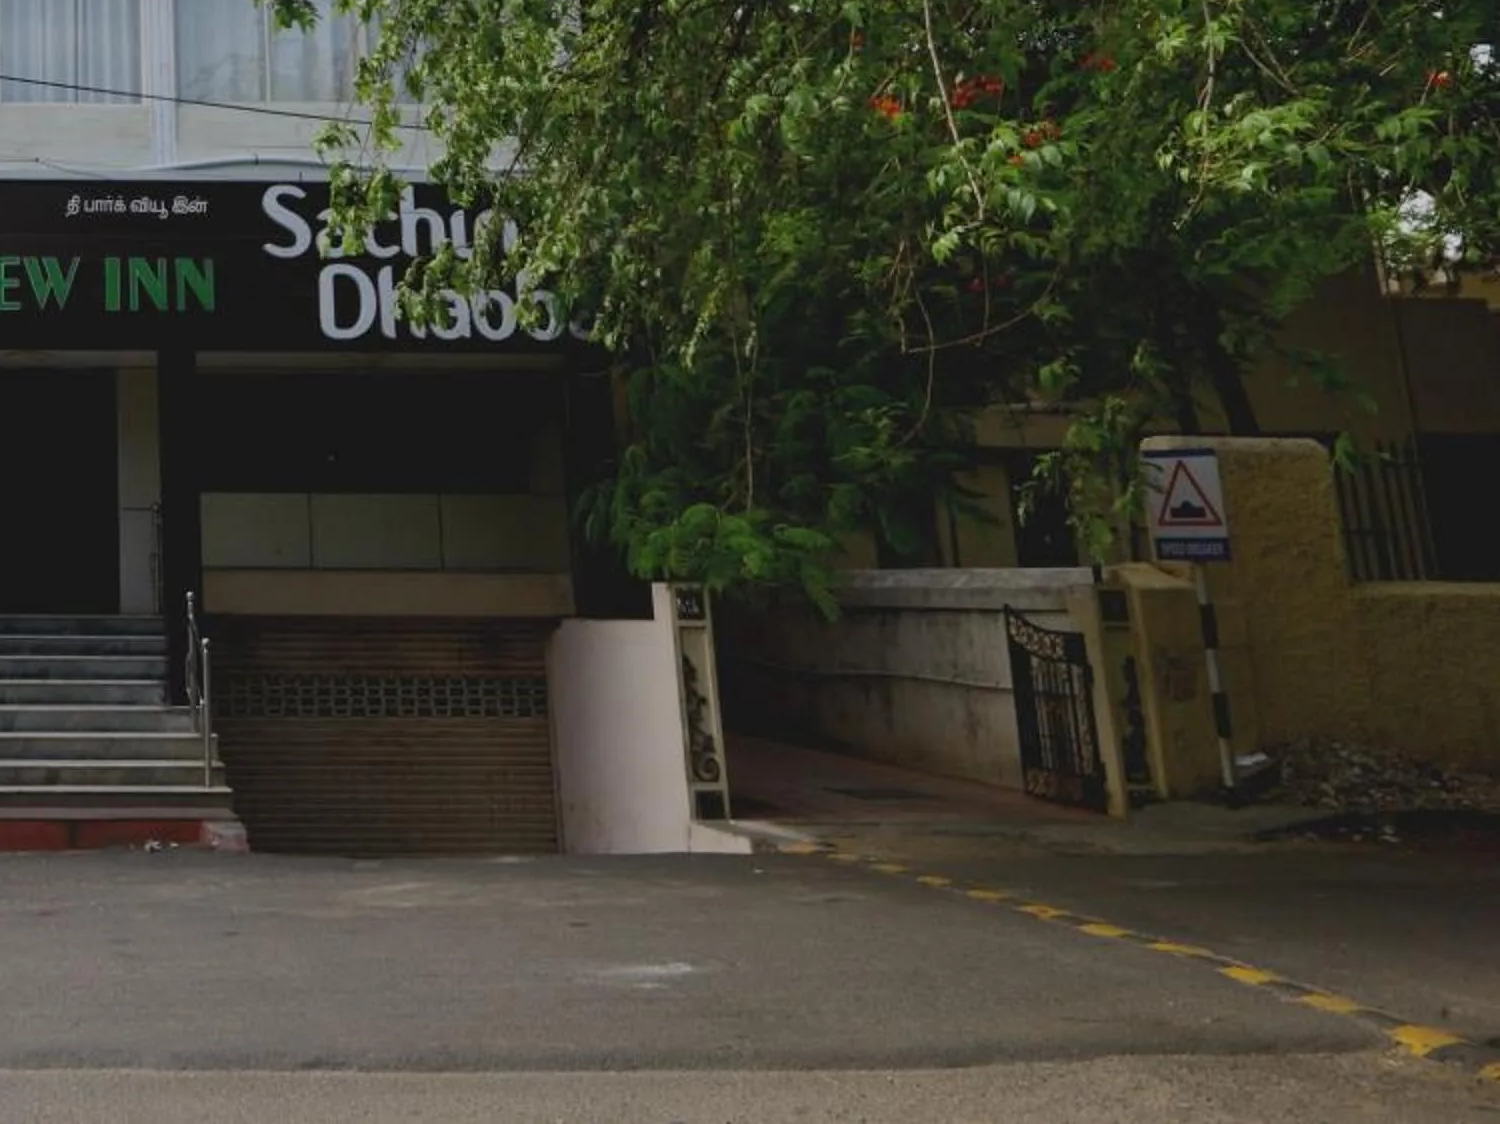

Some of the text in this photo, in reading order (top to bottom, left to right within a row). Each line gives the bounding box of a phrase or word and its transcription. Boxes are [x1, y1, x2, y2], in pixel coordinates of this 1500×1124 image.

[84, 194, 127, 213] பார்க்
[171, 194, 209, 215] இன்
[104, 257, 215, 312] INN
